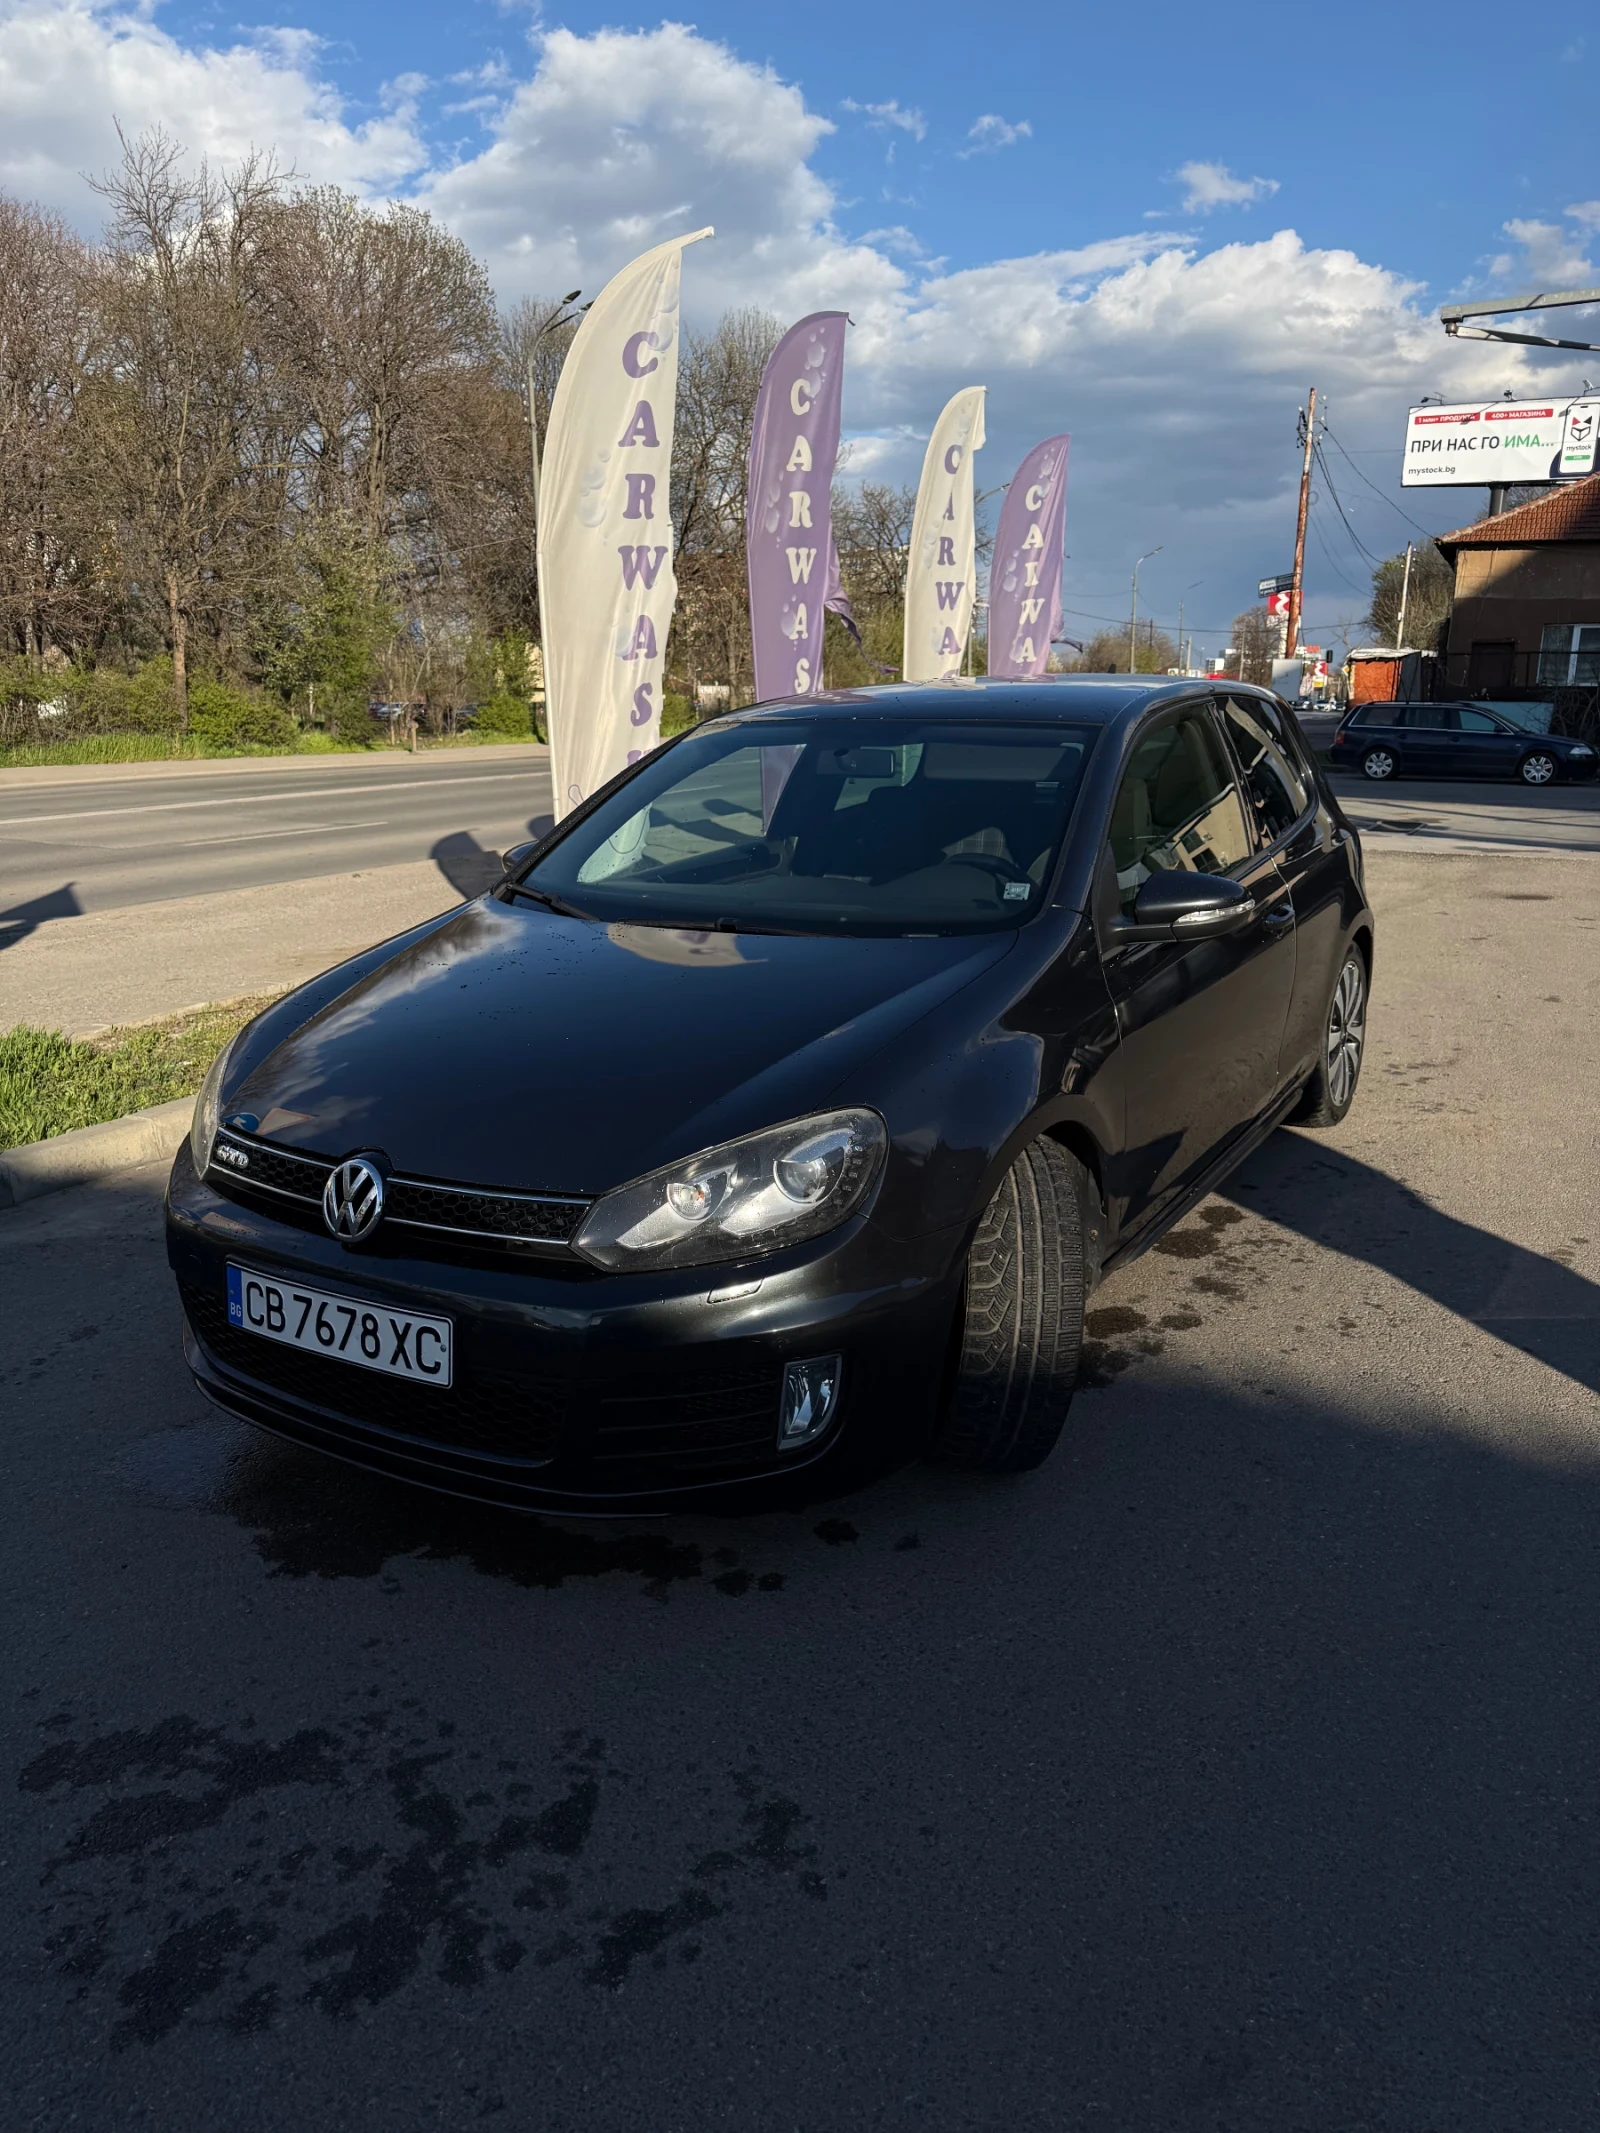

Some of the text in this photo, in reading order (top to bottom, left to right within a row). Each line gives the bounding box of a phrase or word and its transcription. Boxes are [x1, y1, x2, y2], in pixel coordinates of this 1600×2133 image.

[1509, 410, 1546, 418] МАГАЗИНА
[1411, 439, 1442, 453] ПРИ
[1447, 437, 1477, 451] НАС
[1481, 436, 1500, 449] ГО
[1566, 444, 1592, 452] mystock
[1408, 466, 1456, 476] mystock.bg
[935, 444, 965, 677] CARWA
[230, 1301, 242, 1318] BG
